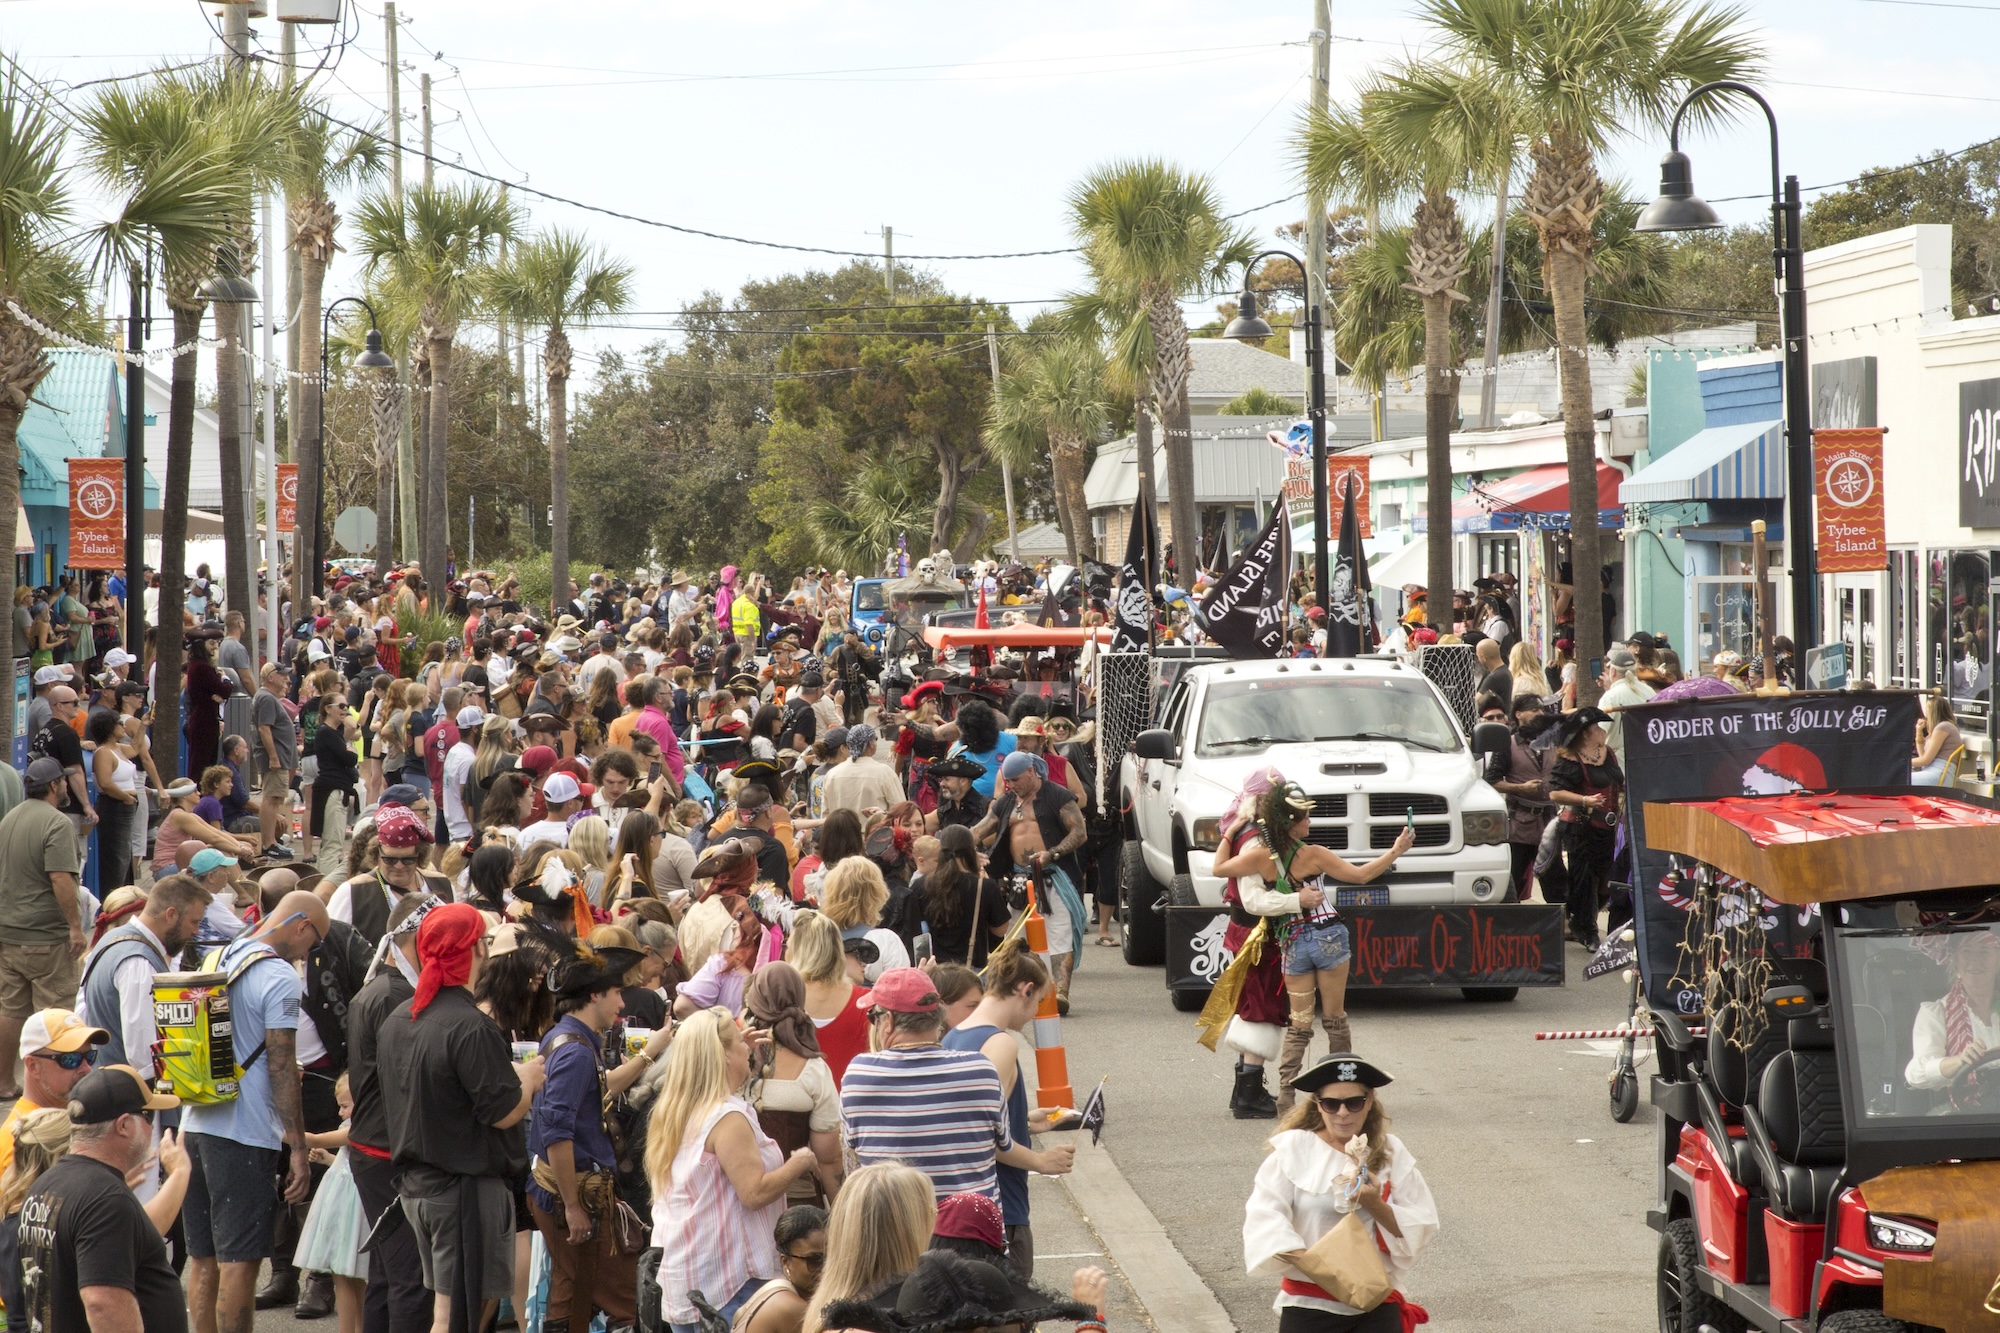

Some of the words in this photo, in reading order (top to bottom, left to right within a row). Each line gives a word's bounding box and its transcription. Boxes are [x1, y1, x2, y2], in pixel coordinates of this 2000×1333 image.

[1824, 452, 1847, 466] Main
[1849, 450, 1874, 465] Street
[76, 475, 94, 487] Main
[95, 473, 116, 487] Street
[1285, 479, 1315, 499] HOU
[1289, 502, 1314, 511] RESTAU
[1523, 513, 1602, 527] ARCAE
[77, 532, 109, 543] Tybee
[1826, 524, 1867, 539] Tybee
[83, 544, 116, 554] Island
[1835, 538, 1878, 553] Island
[1647, 717, 1714, 744] ORDER
[1720, 714, 1744, 735] OF
[1751, 711, 1784, 732] THE
[1787, 706, 1846, 734] JOLLY
[1842, 704, 1887, 733] ELF
[1354, 917, 1424, 986] KREWE
[1430, 914, 1462, 974] OF
[1468, 907, 1542, 975] MISFITS
[157, 1003, 192, 1020] SHITI
